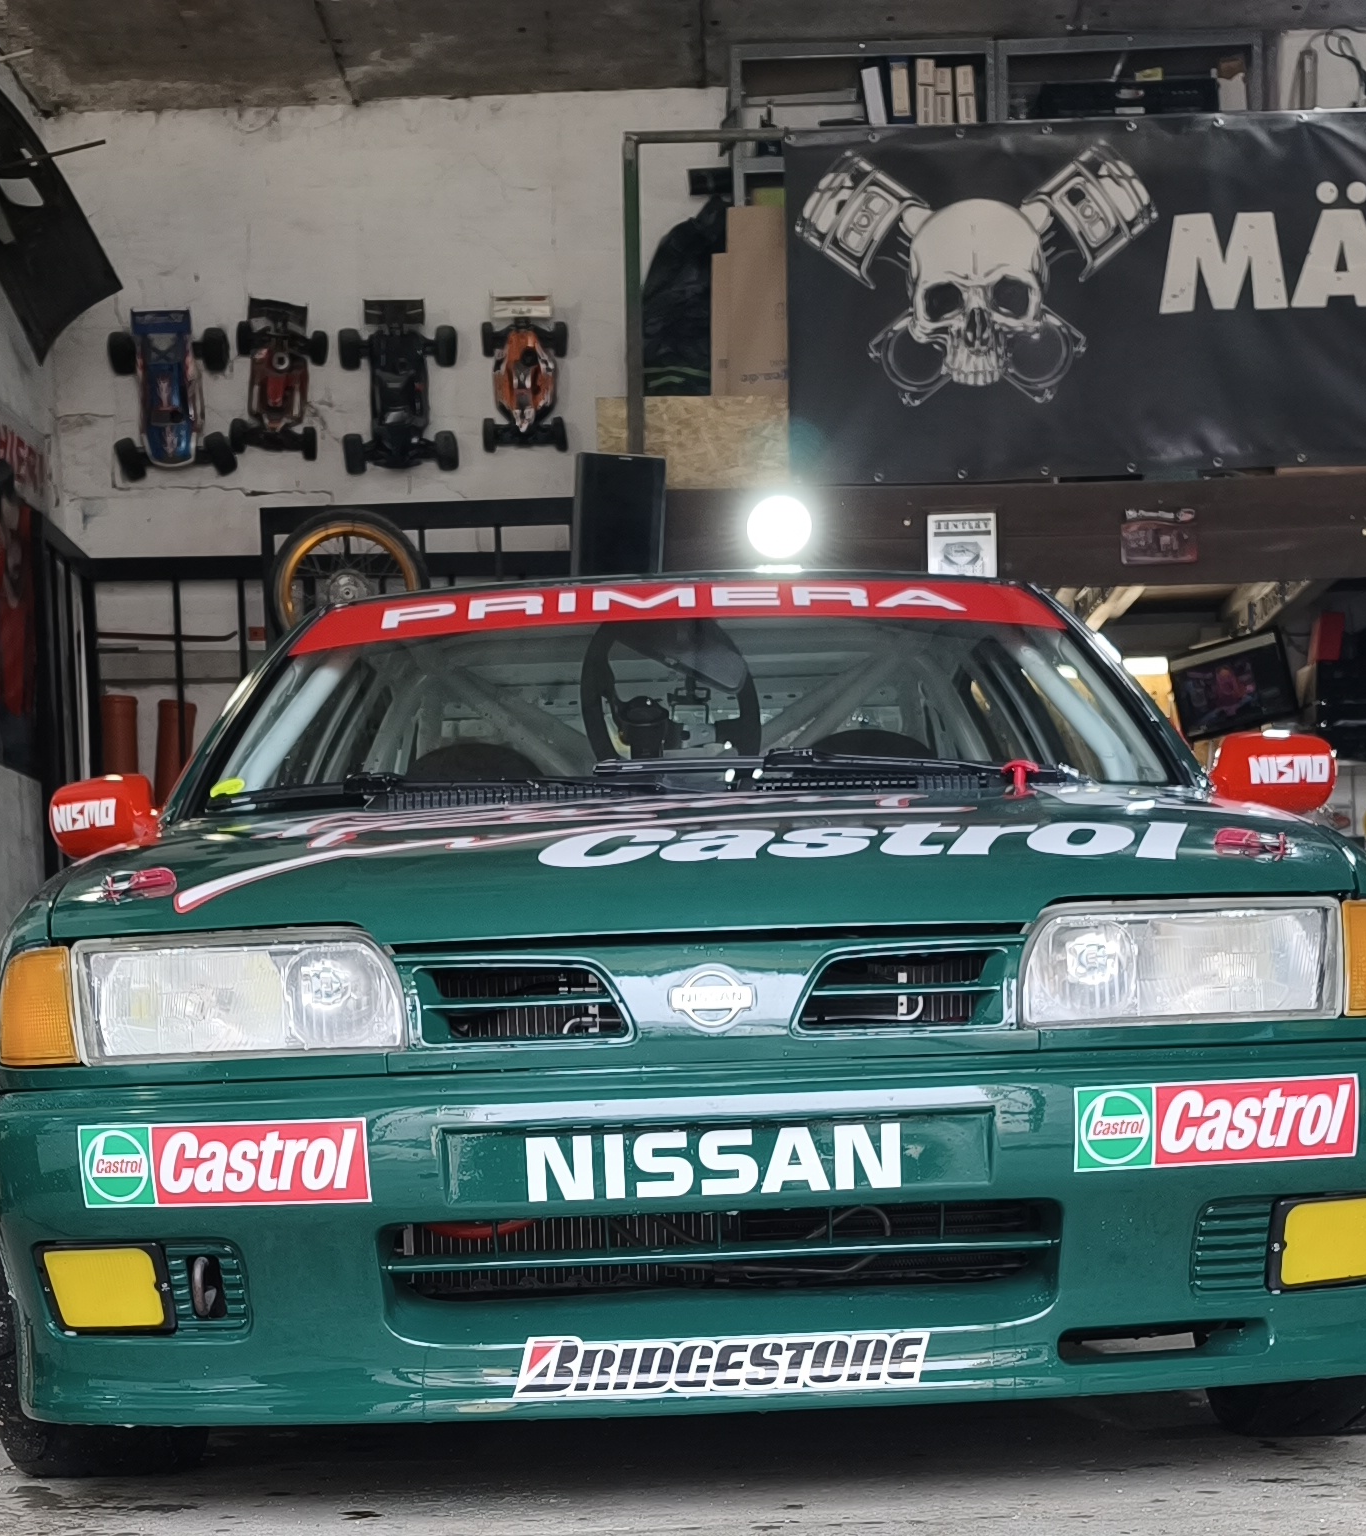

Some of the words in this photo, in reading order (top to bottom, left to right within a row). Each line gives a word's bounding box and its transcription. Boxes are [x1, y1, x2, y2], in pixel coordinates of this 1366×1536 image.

[381, 585, 968, 630] PRIMERA
[1248, 754, 1331, 786] NISMO
[51, 797, 116, 834] NISMO
[539, 820, 1187, 868] Castrol
[1093, 1117, 1145, 1137] Castrol
[1160, 1084, 1352, 1154] Castrol
[95, 1156, 143, 1175] Castrol
[159, 1127, 358, 1194] Castrol
[525, 1122, 902, 1203] NISSAN
[517, 1334, 930, 1396] BRIDGESTONE
